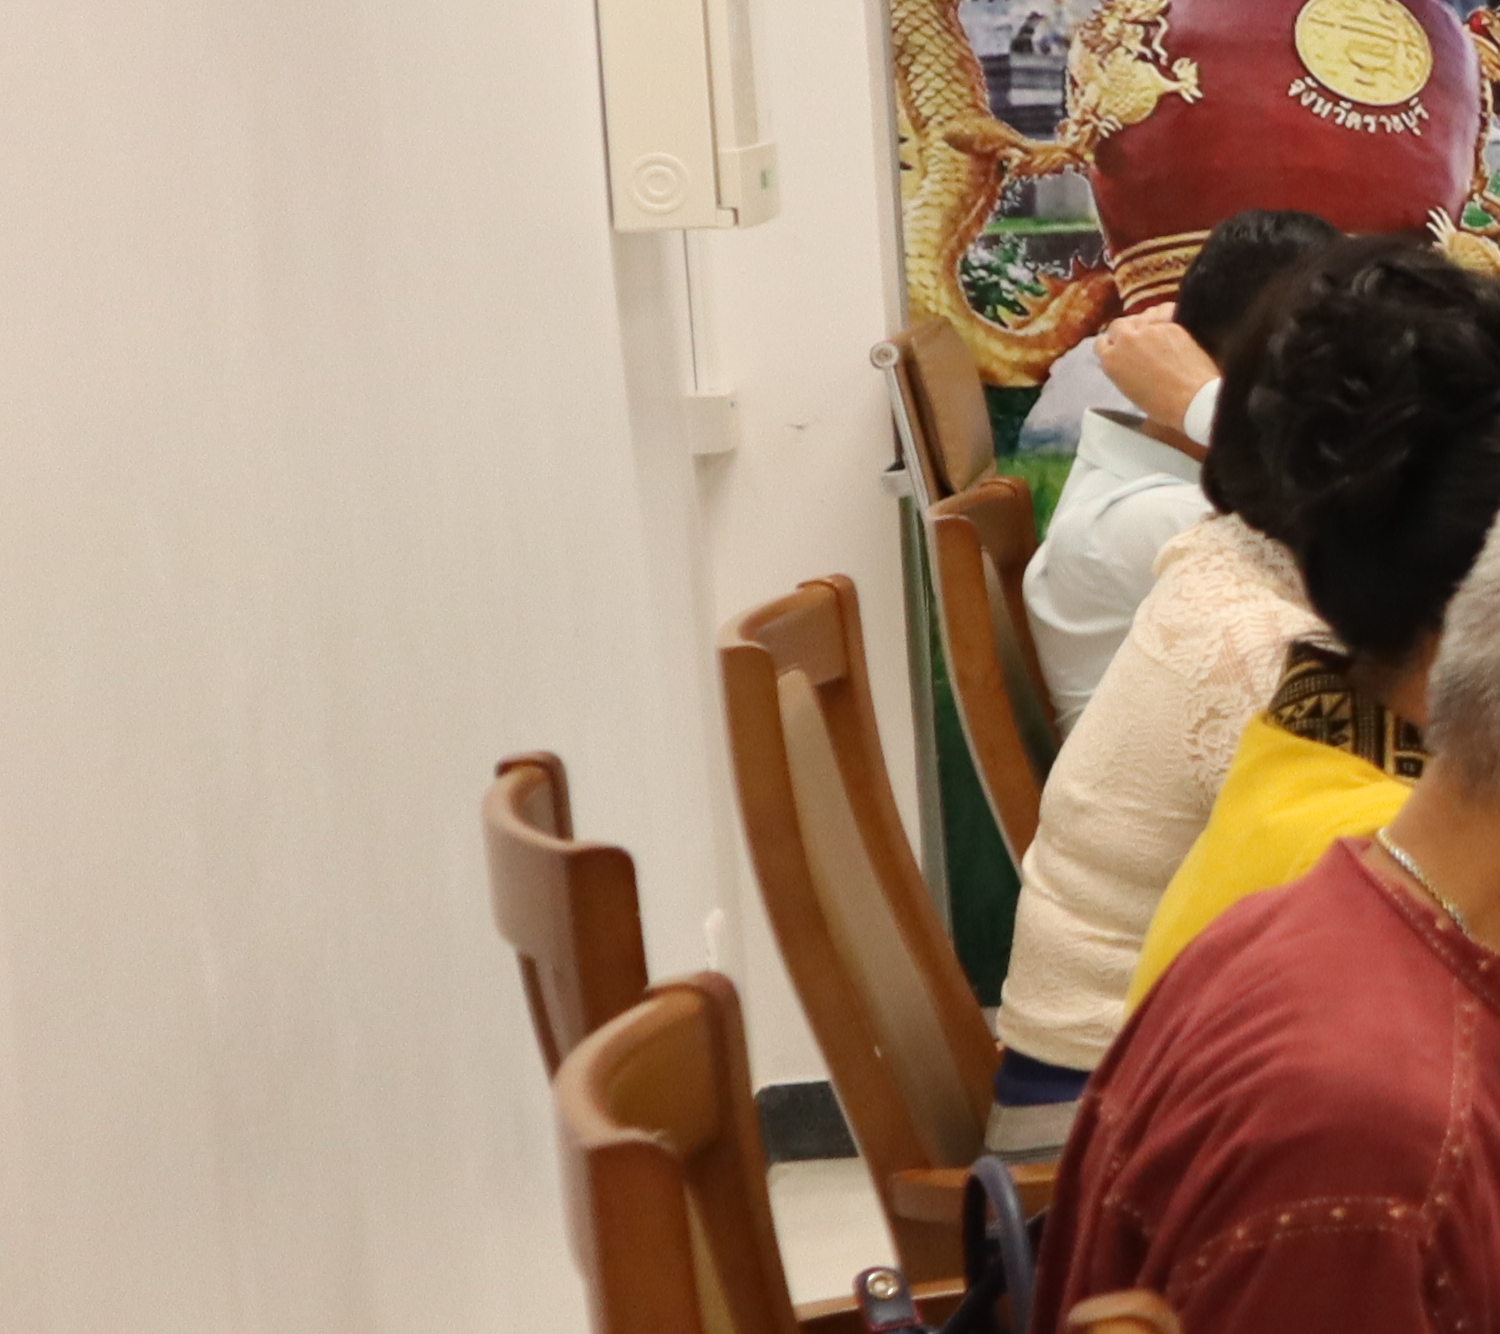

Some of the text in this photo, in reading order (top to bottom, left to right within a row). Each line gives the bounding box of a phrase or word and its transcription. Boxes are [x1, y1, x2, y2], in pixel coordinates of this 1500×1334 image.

[1287, 75, 1430, 137] จังหวัดราชบุรี
